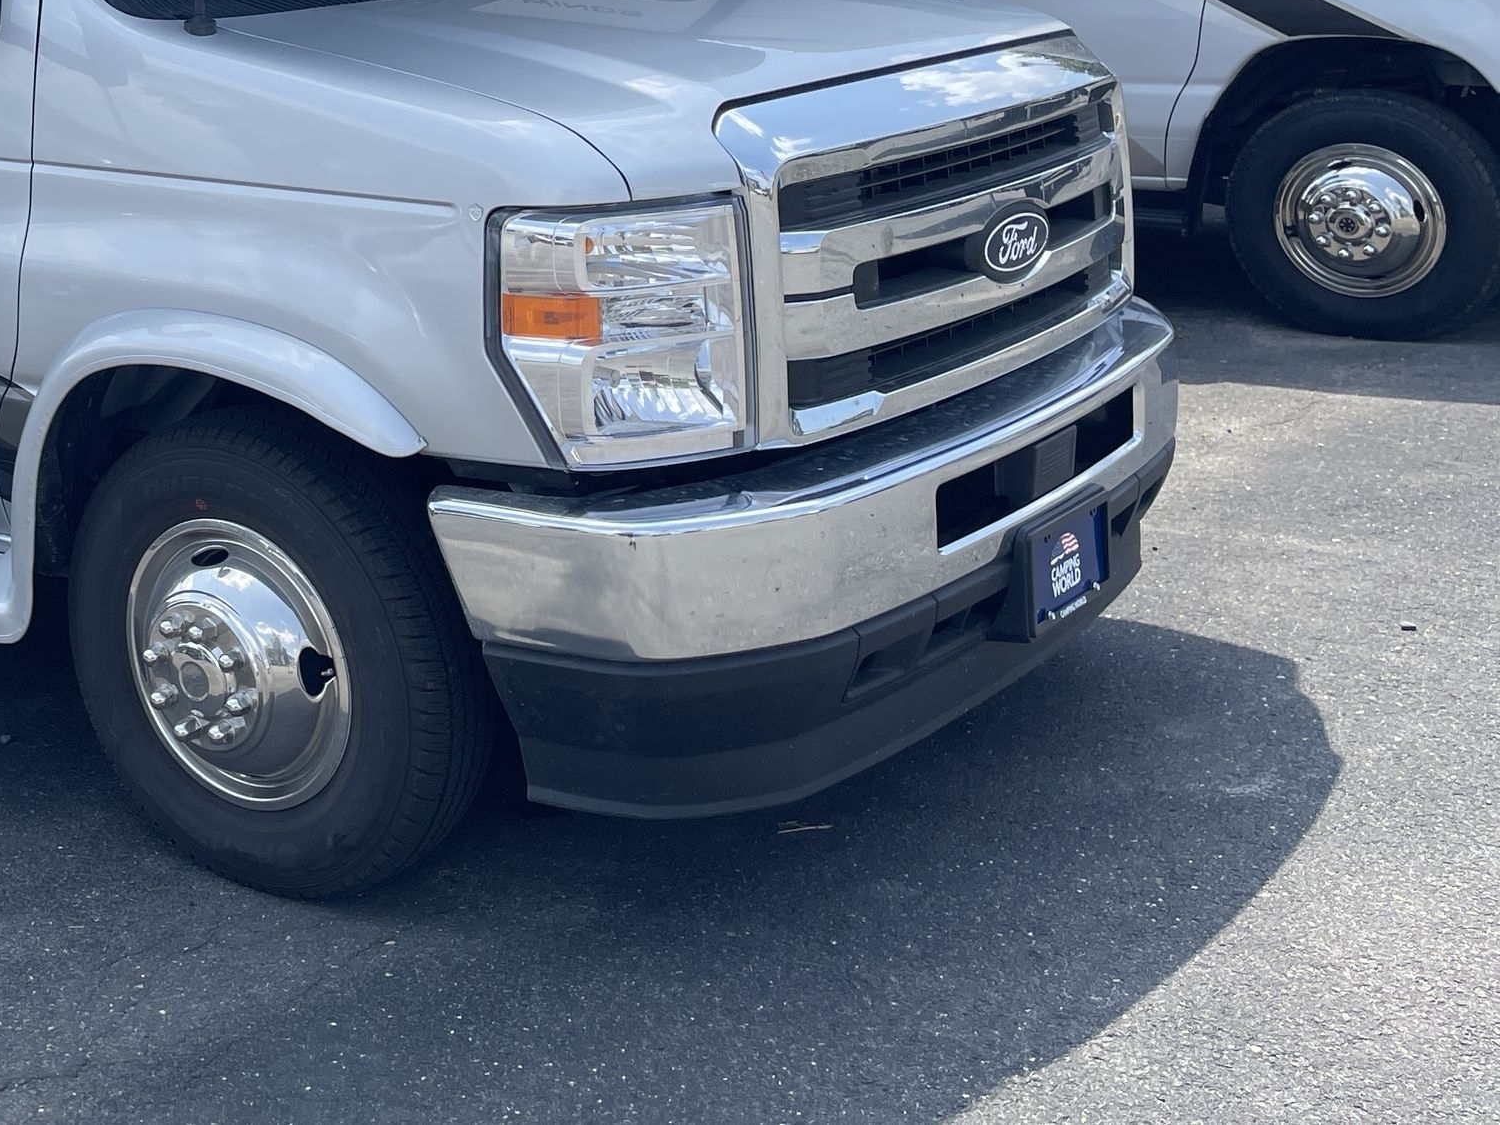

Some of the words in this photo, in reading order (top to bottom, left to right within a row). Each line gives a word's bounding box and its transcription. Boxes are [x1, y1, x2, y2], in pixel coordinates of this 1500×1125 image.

[999, 221, 1038, 265] Ford
[1051, 553, 1081, 582] CAMPING
[1052, 567, 1081, 598] WORLD
[1060, 603, 1077, 618] CAMPING
